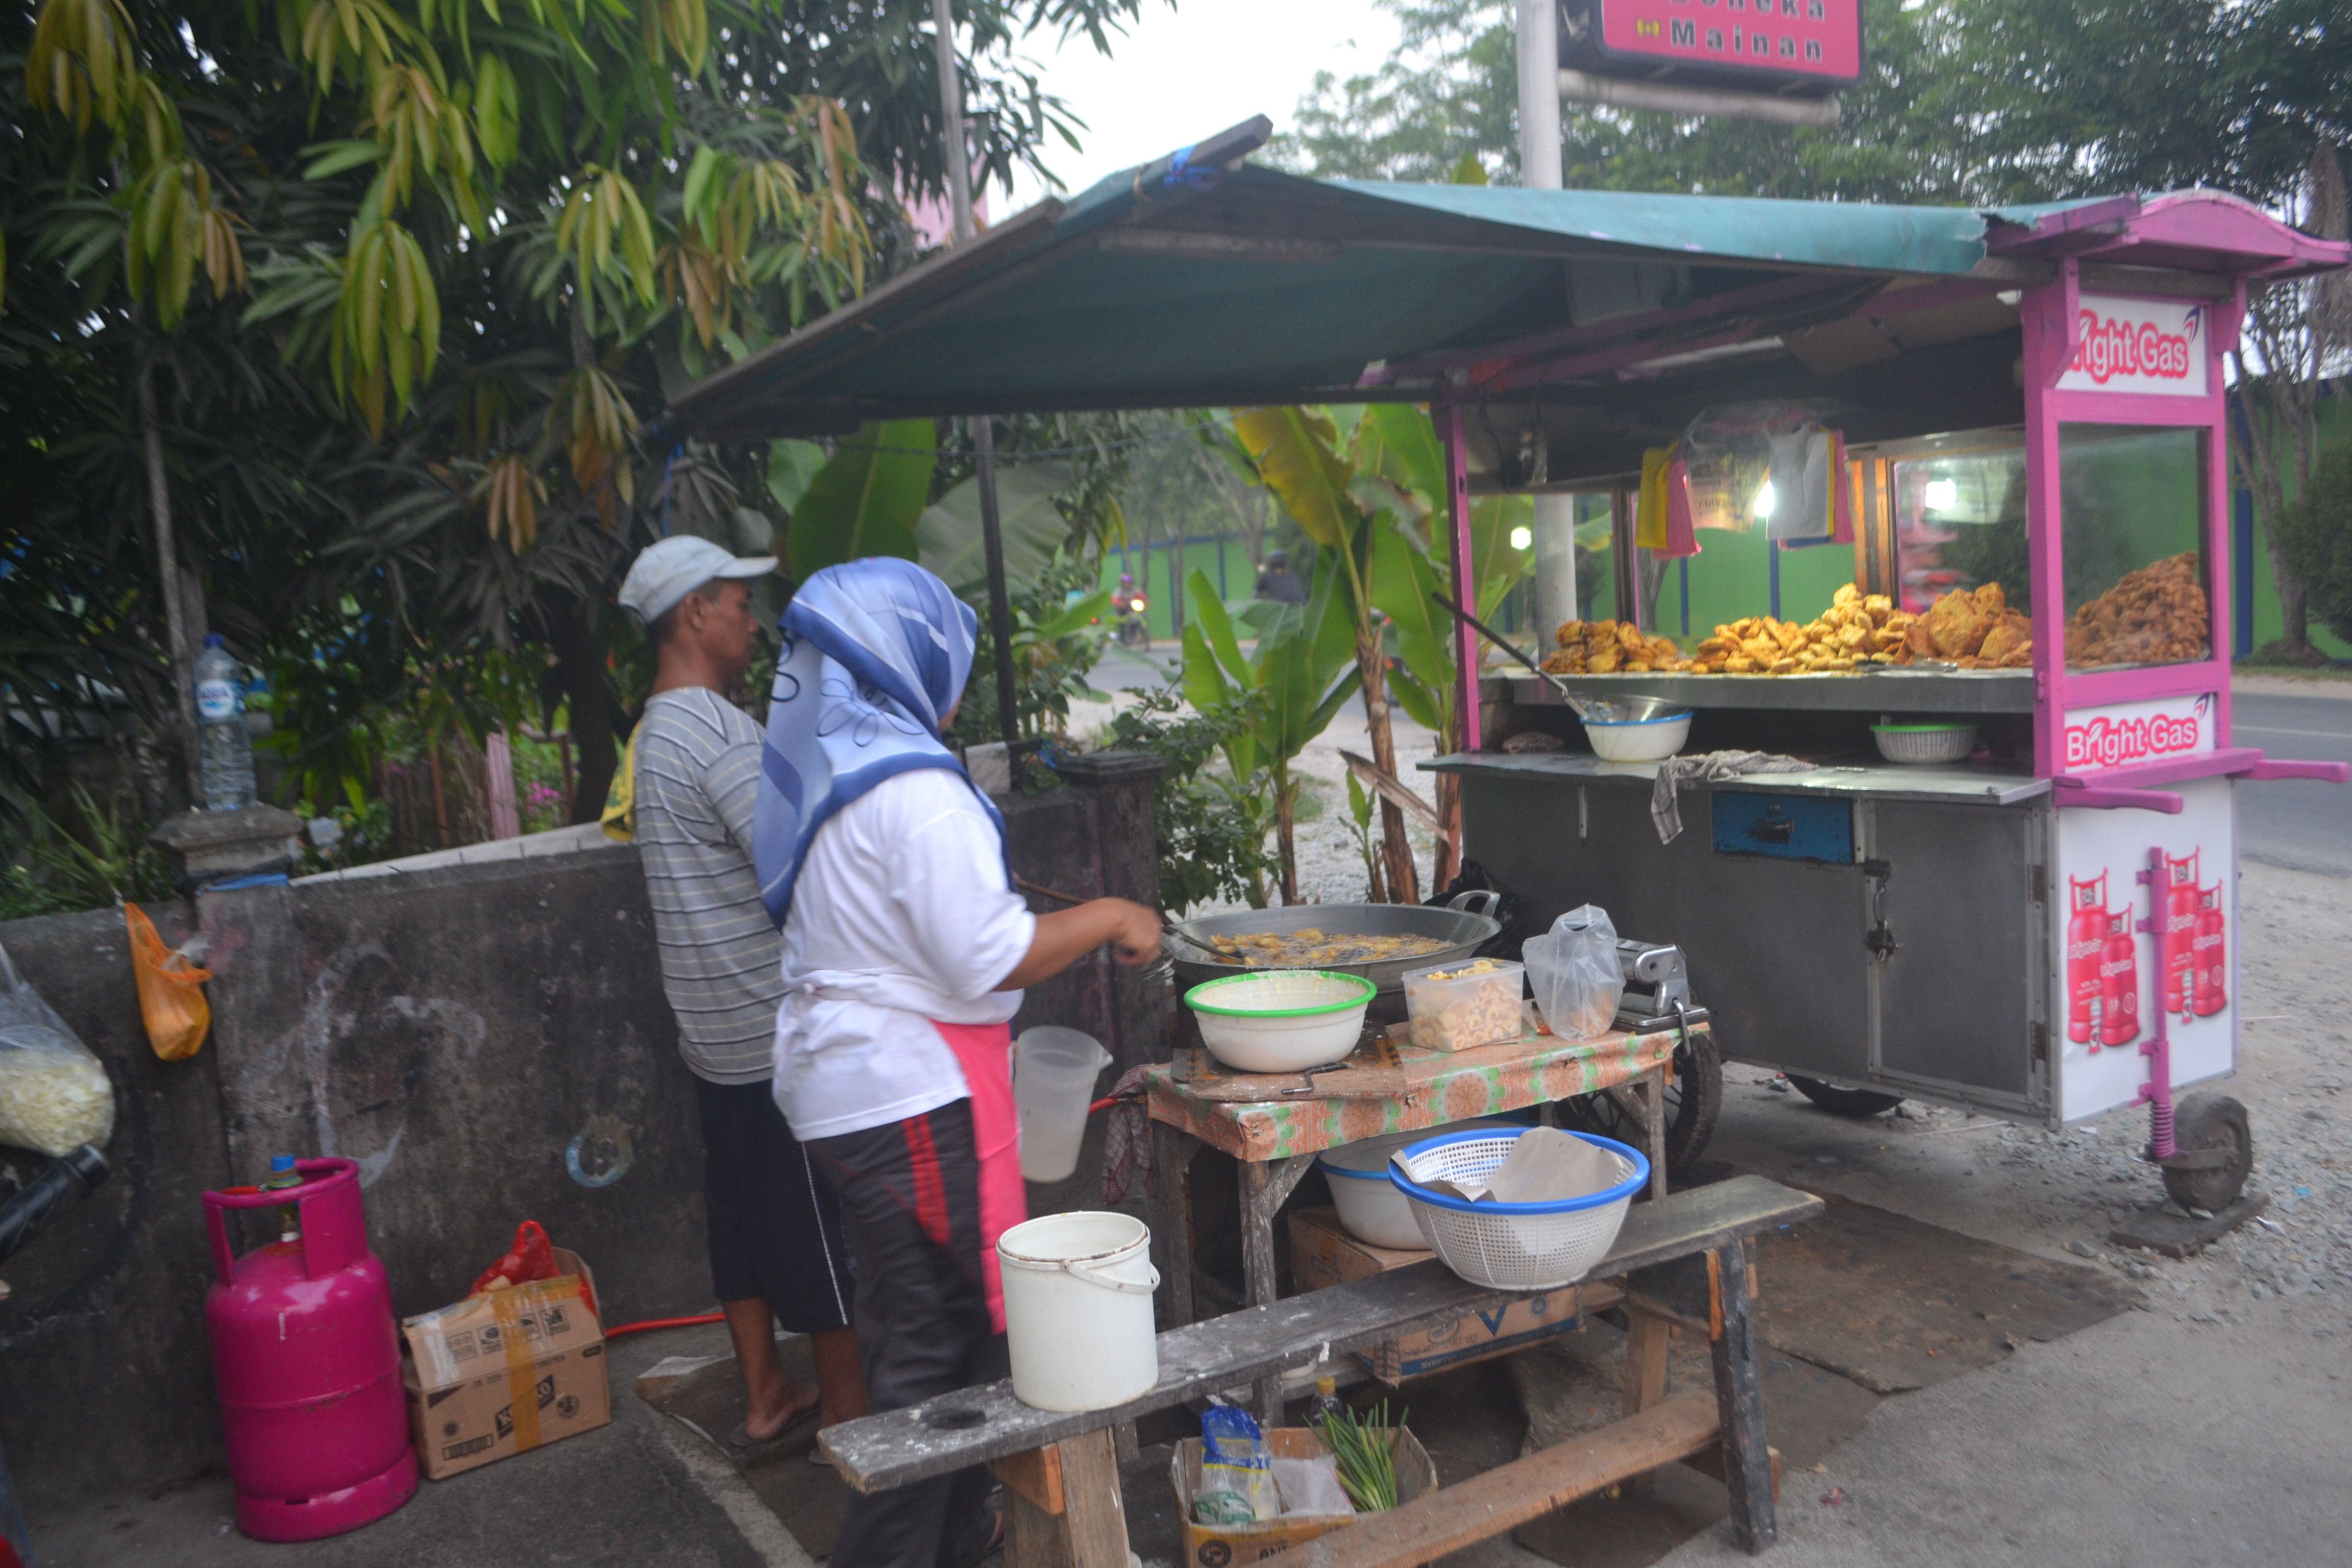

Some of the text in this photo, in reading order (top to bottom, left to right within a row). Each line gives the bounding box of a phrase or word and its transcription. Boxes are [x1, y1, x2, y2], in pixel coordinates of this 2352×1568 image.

[1670, 0, 1824, 22] eka
[1671, 16, 1822, 63] Mainan
[2074, 312, 2187, 380] ight Gas
[2066, 716, 2196, 765] Bright Gas
